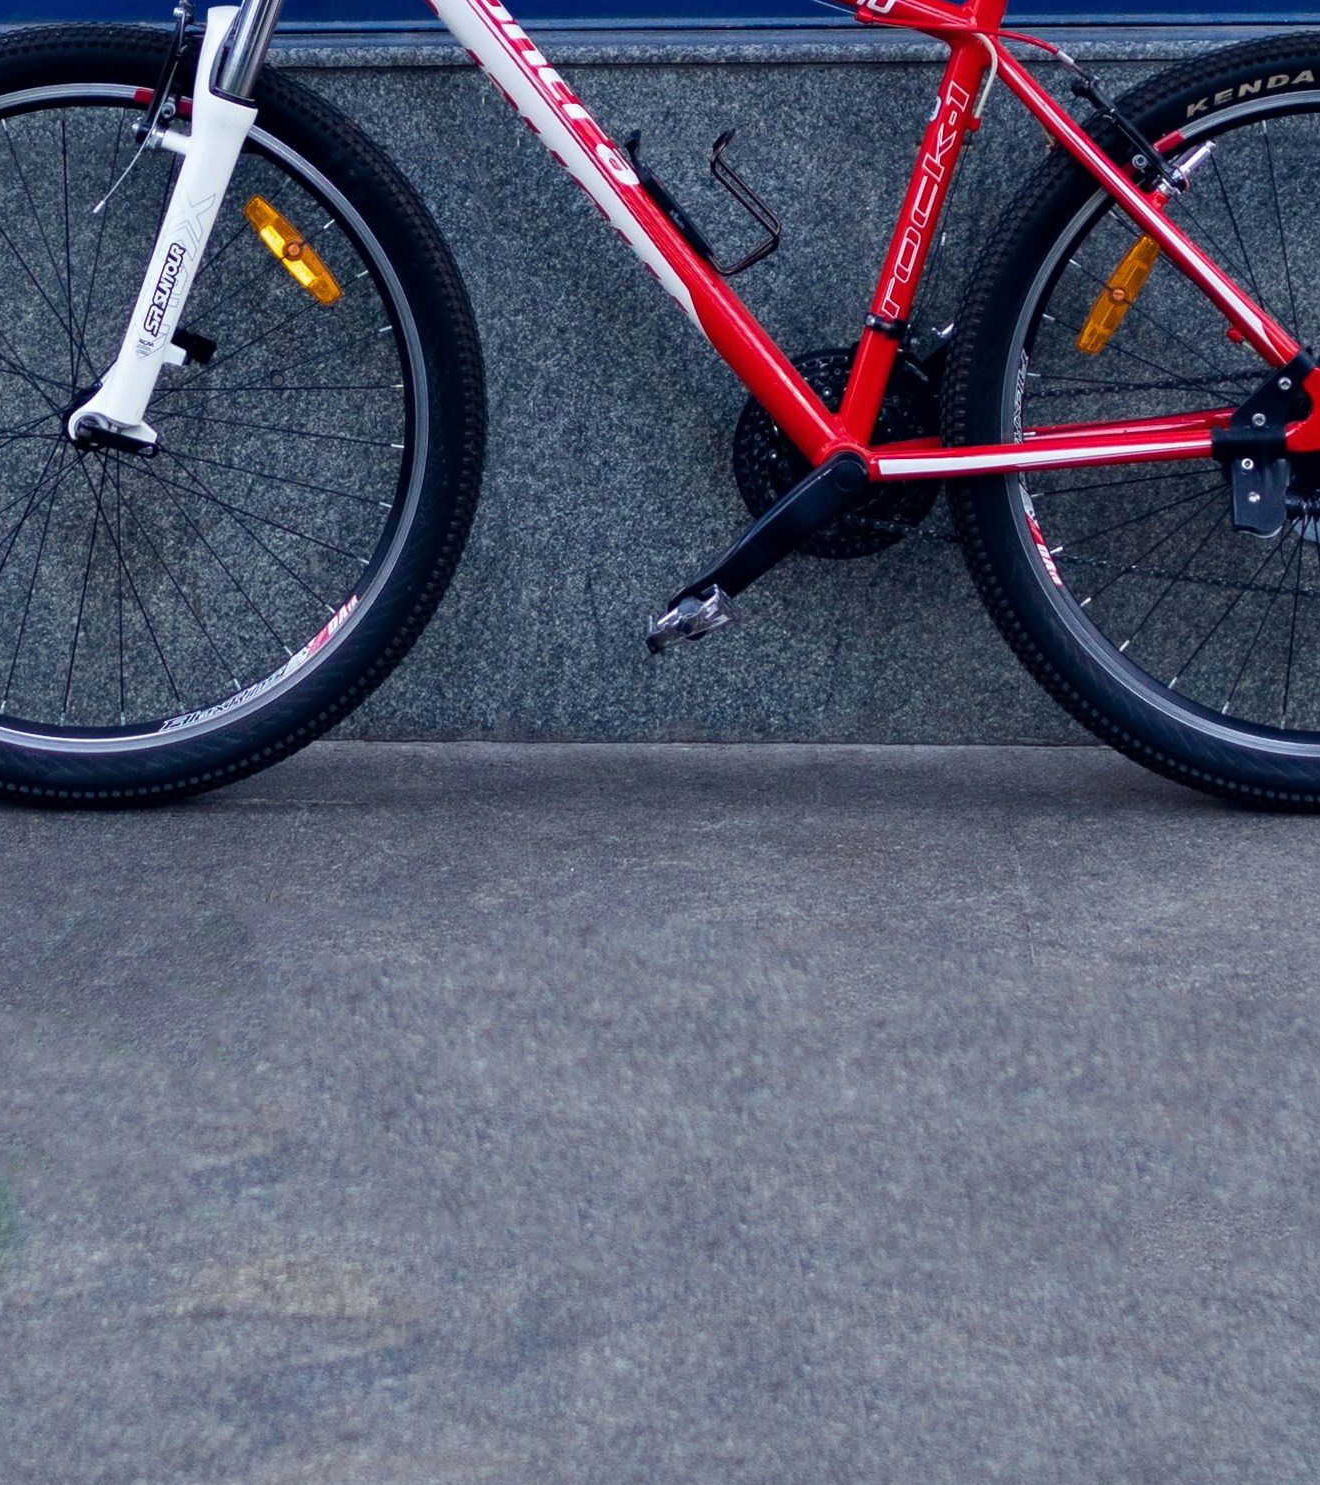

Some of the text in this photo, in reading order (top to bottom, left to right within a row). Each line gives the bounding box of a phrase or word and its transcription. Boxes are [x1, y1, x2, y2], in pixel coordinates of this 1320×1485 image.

[1186, 69, 1315, 118] KENDA
[881, 80, 971, 319] rock-1
[152, 242, 187, 310] SUNTOUR
[143, 304, 165, 338] SR
